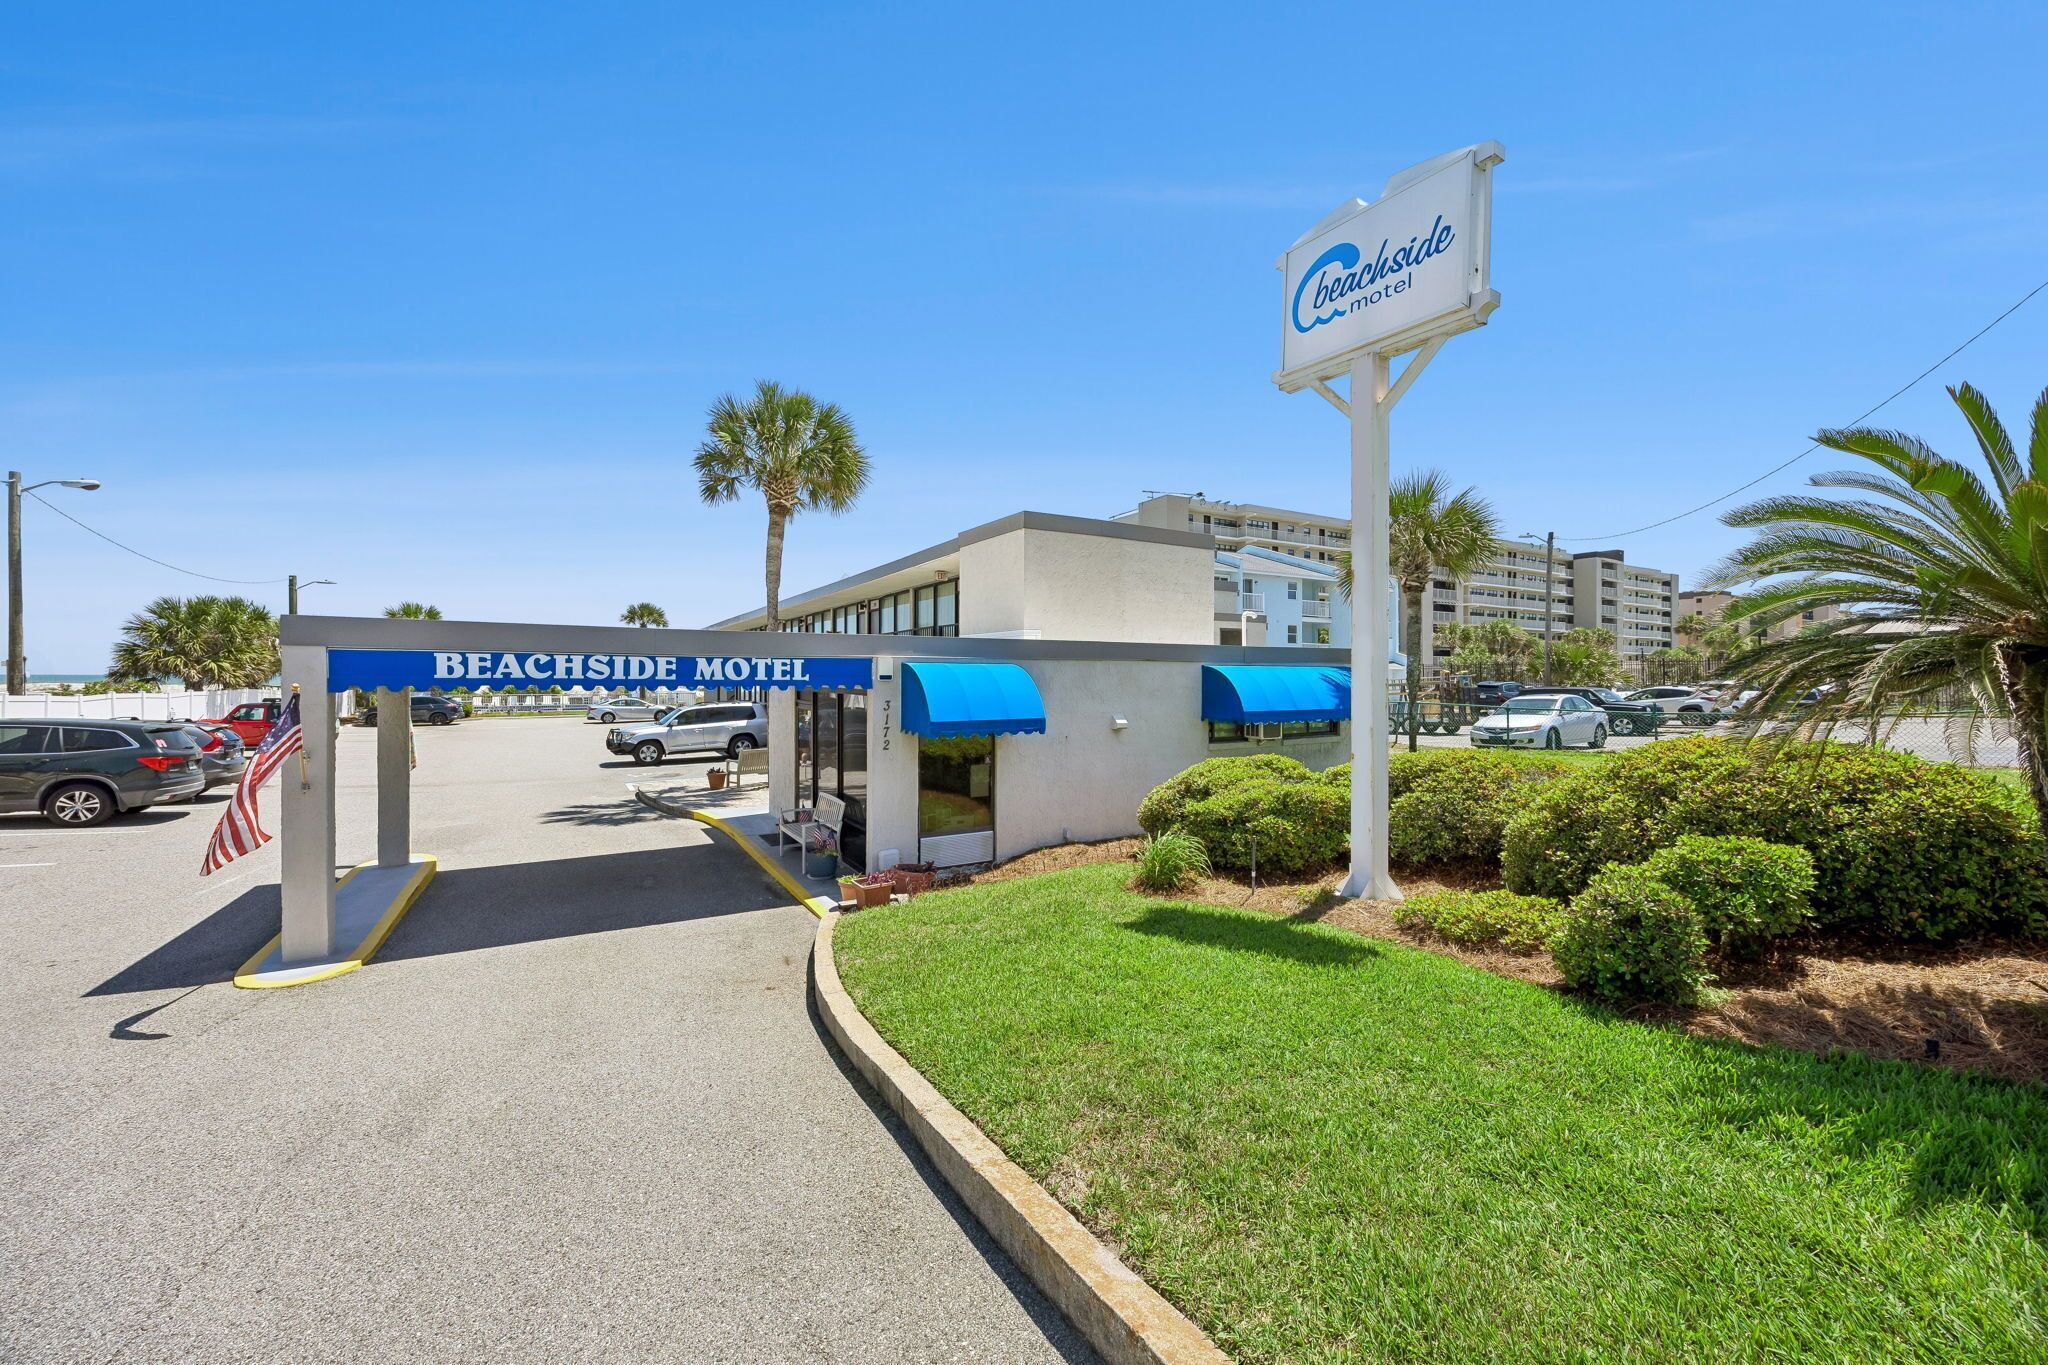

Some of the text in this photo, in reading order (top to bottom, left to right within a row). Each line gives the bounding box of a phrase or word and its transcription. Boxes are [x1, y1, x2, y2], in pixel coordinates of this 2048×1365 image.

[1313, 214, 1456, 309] beachside
[1350, 271, 1412, 313] motel
[433, 652, 810, 681] BEACHSIDE MOTEL
[882, 700, 891, 751] 3172
